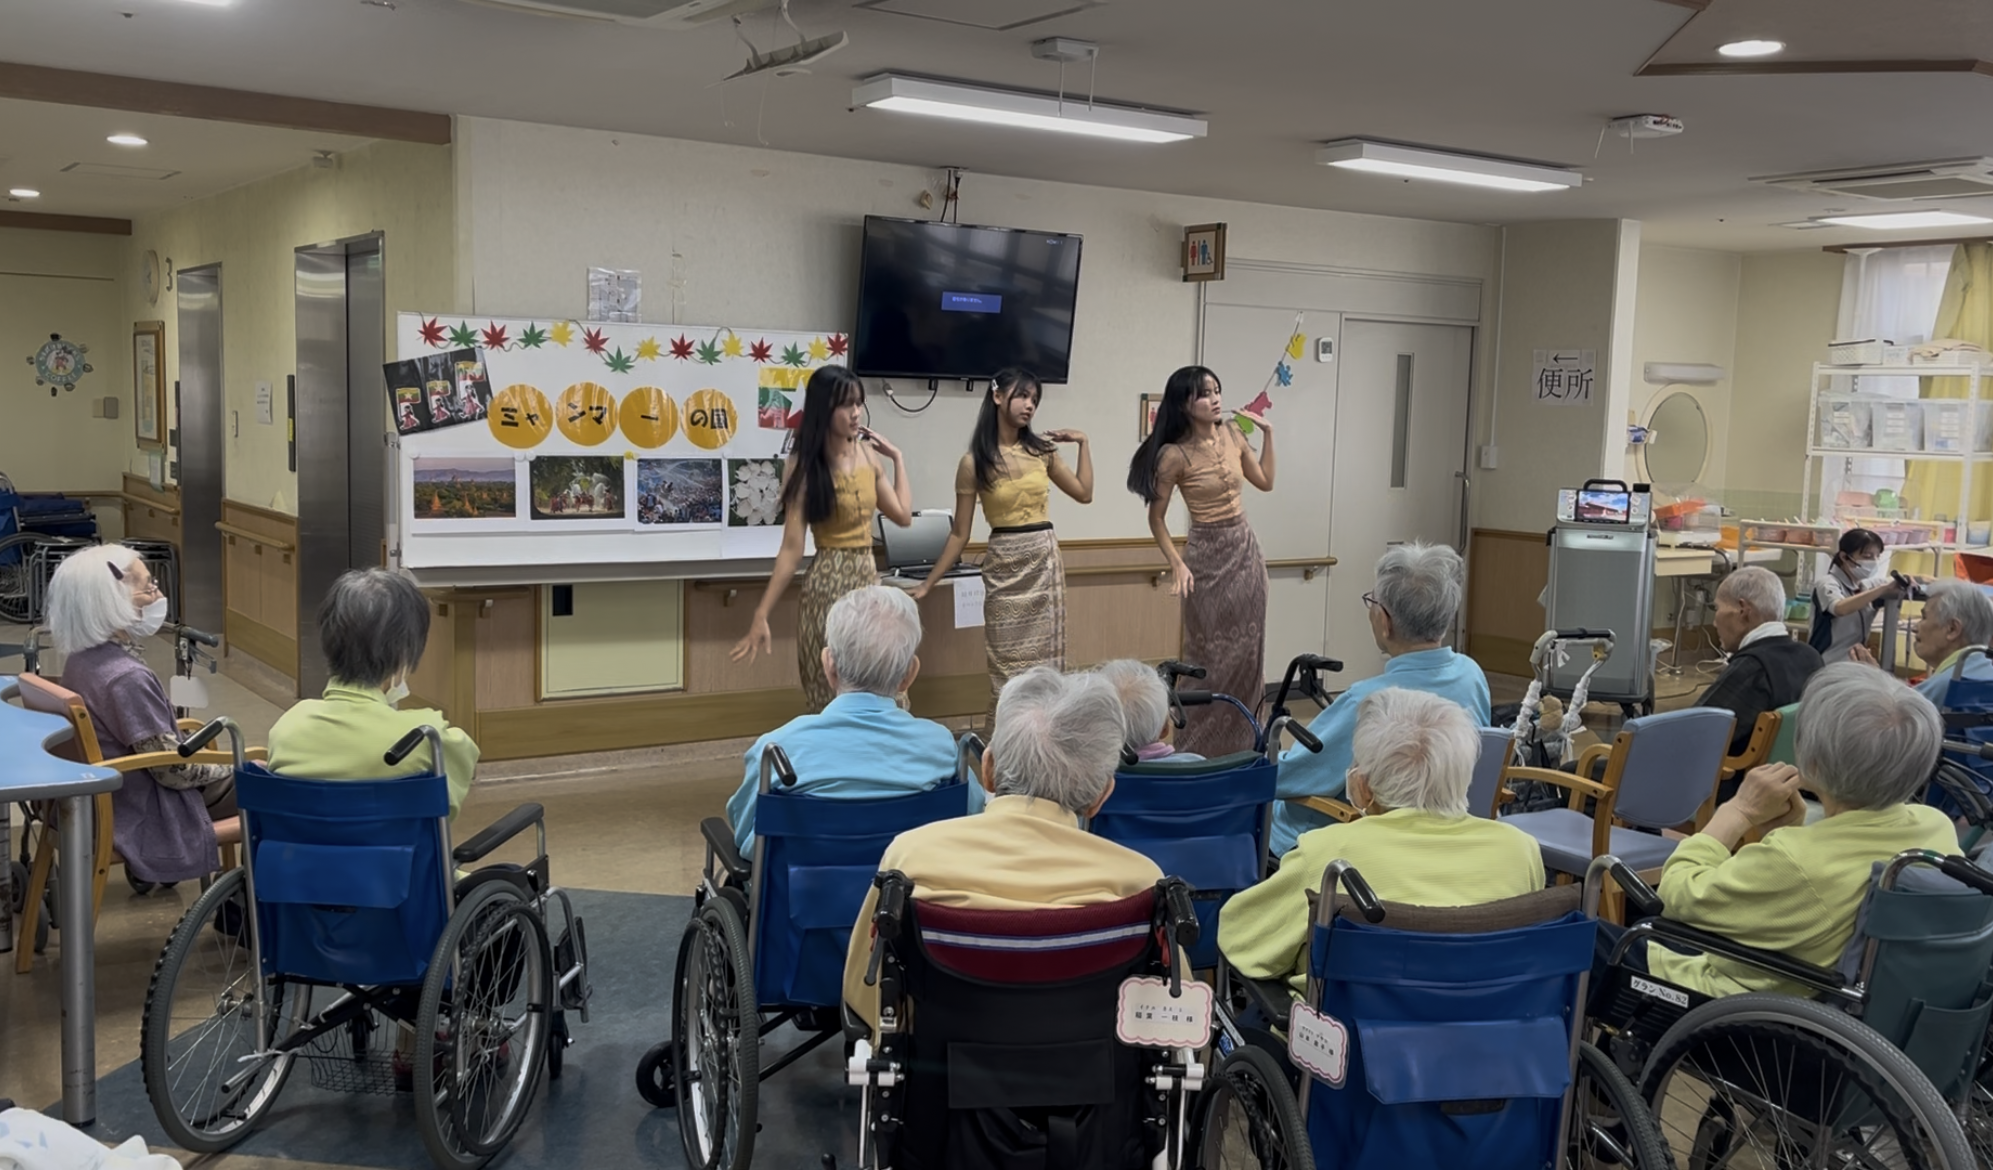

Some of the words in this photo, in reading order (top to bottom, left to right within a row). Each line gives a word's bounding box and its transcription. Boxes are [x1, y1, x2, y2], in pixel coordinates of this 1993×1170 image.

[166, 257, 173, 292] 3
[1537, 367, 1594, 400] 便所
[1658, 987, 1687, 1005] No.82
